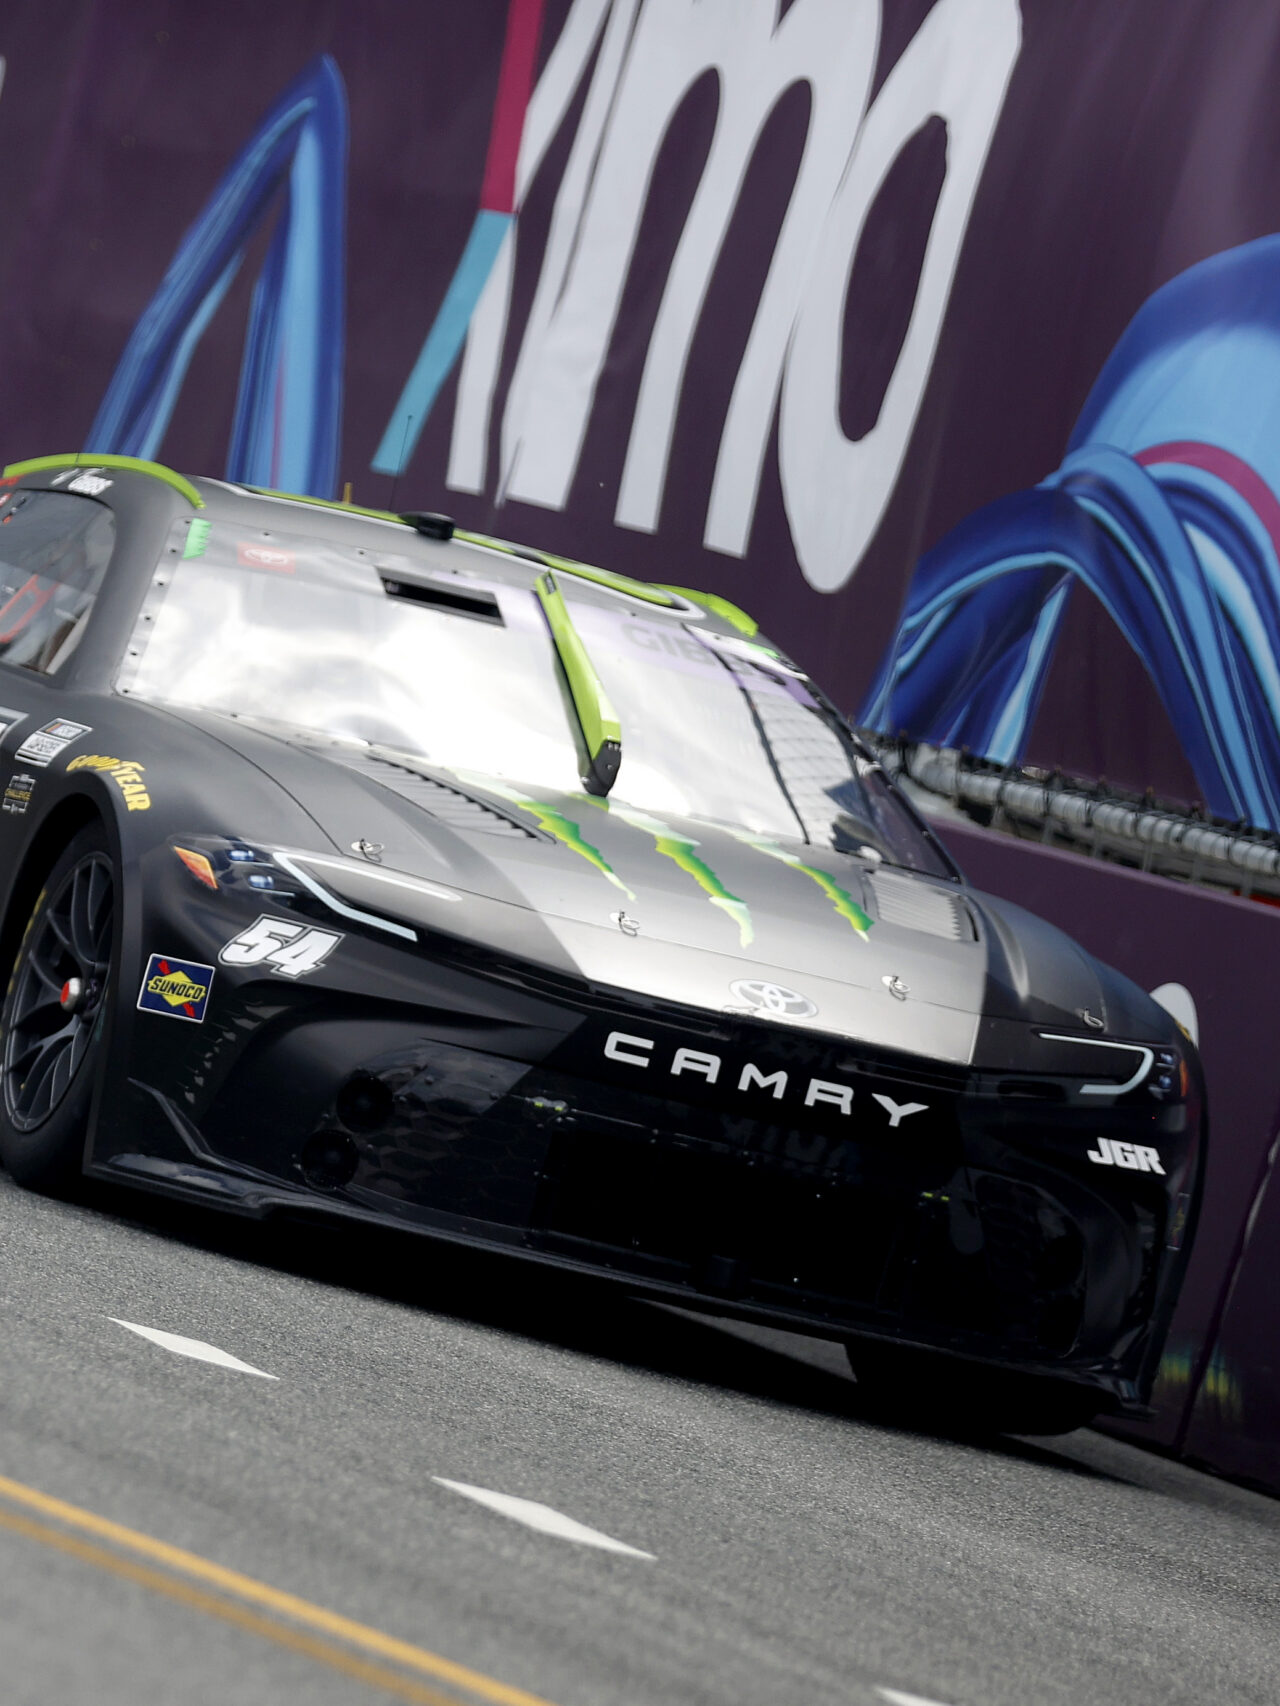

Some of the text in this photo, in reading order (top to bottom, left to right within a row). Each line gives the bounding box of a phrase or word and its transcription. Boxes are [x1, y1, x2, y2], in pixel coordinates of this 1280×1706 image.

[219, 914, 346, 979] 54
[149, 977, 205, 1002] SUNOCO
[604, 1031, 930, 1127] CAMRY
[1087, 1137, 1166, 1176] JGR
